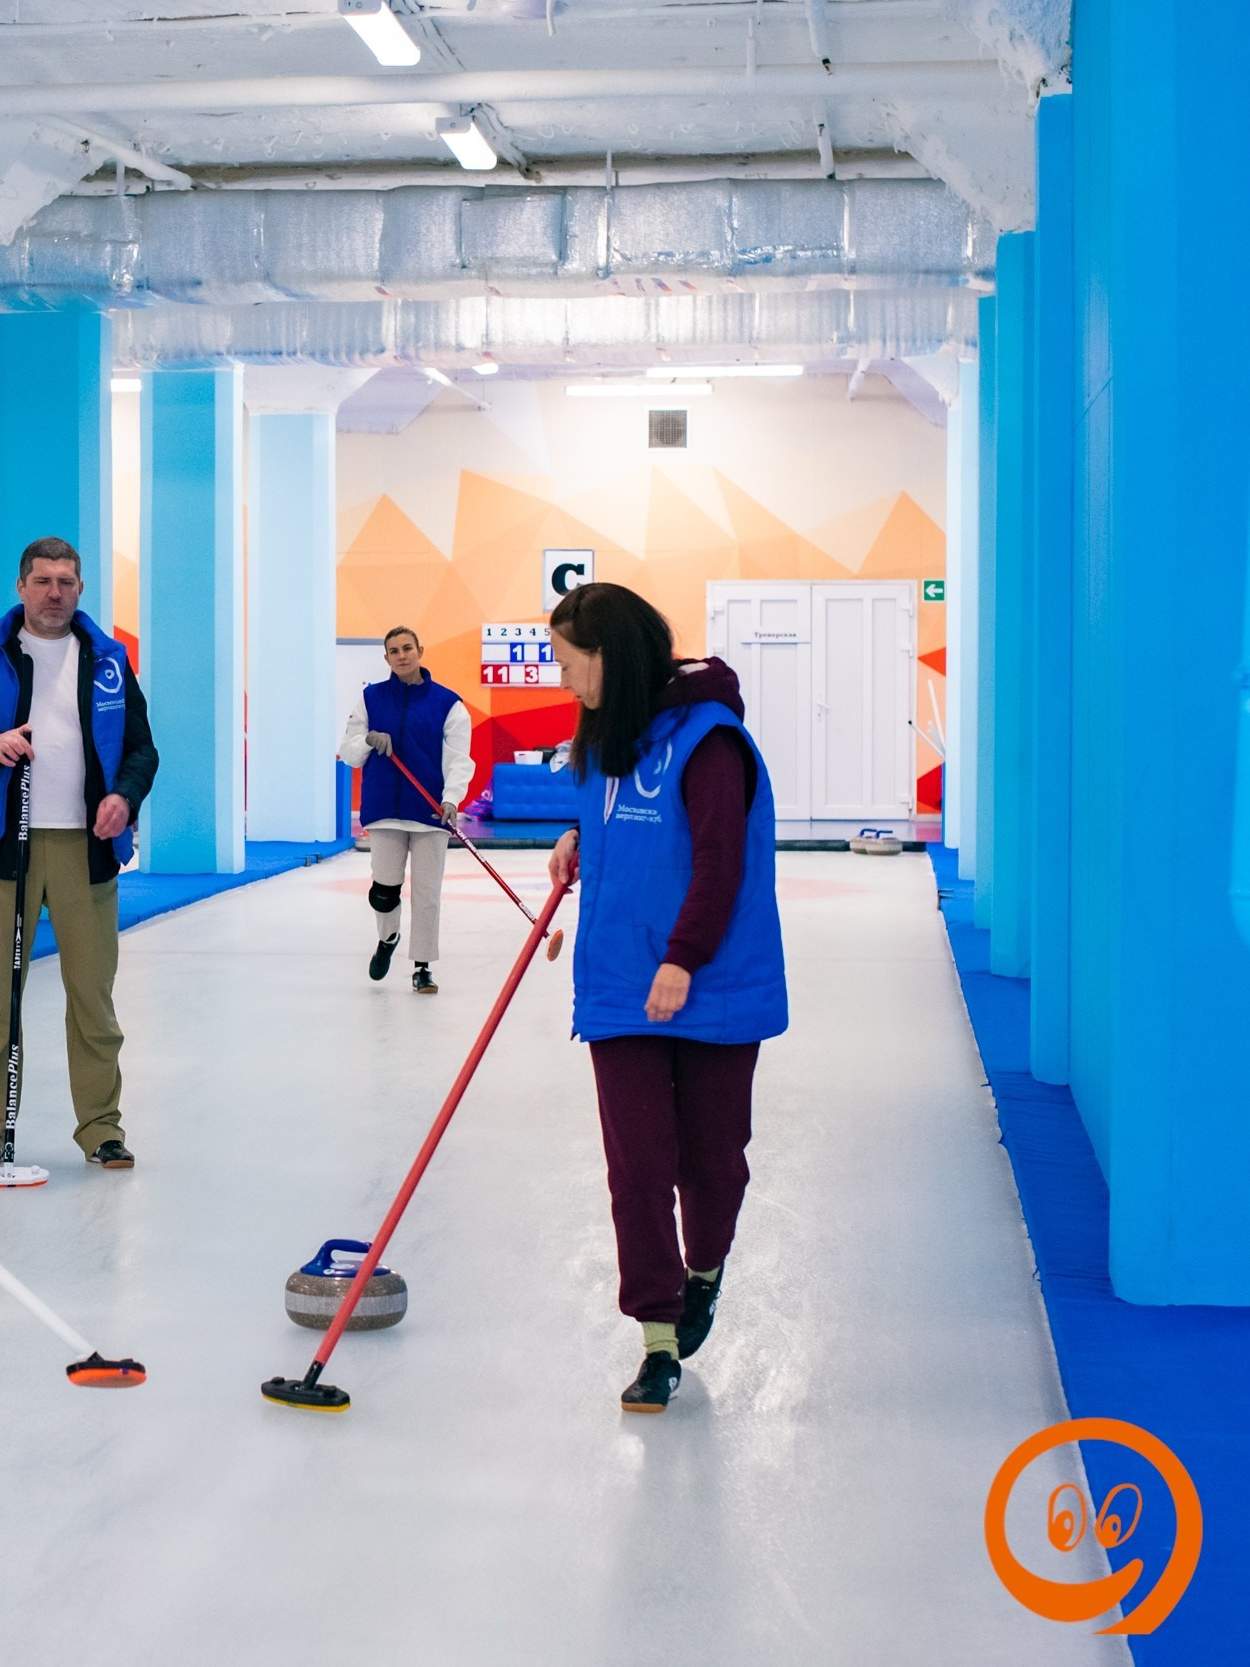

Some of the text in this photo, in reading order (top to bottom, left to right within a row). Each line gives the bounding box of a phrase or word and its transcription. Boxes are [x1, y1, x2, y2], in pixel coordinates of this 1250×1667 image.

[551, 563, 585, 596] C
[487, 628, 550, 636] 1 2 3 4 5
[525, 666, 538, 683] 3
[18, 764, 30, 841] BalancePlus
[6, 1044, 19, 1129] BalancePlus
